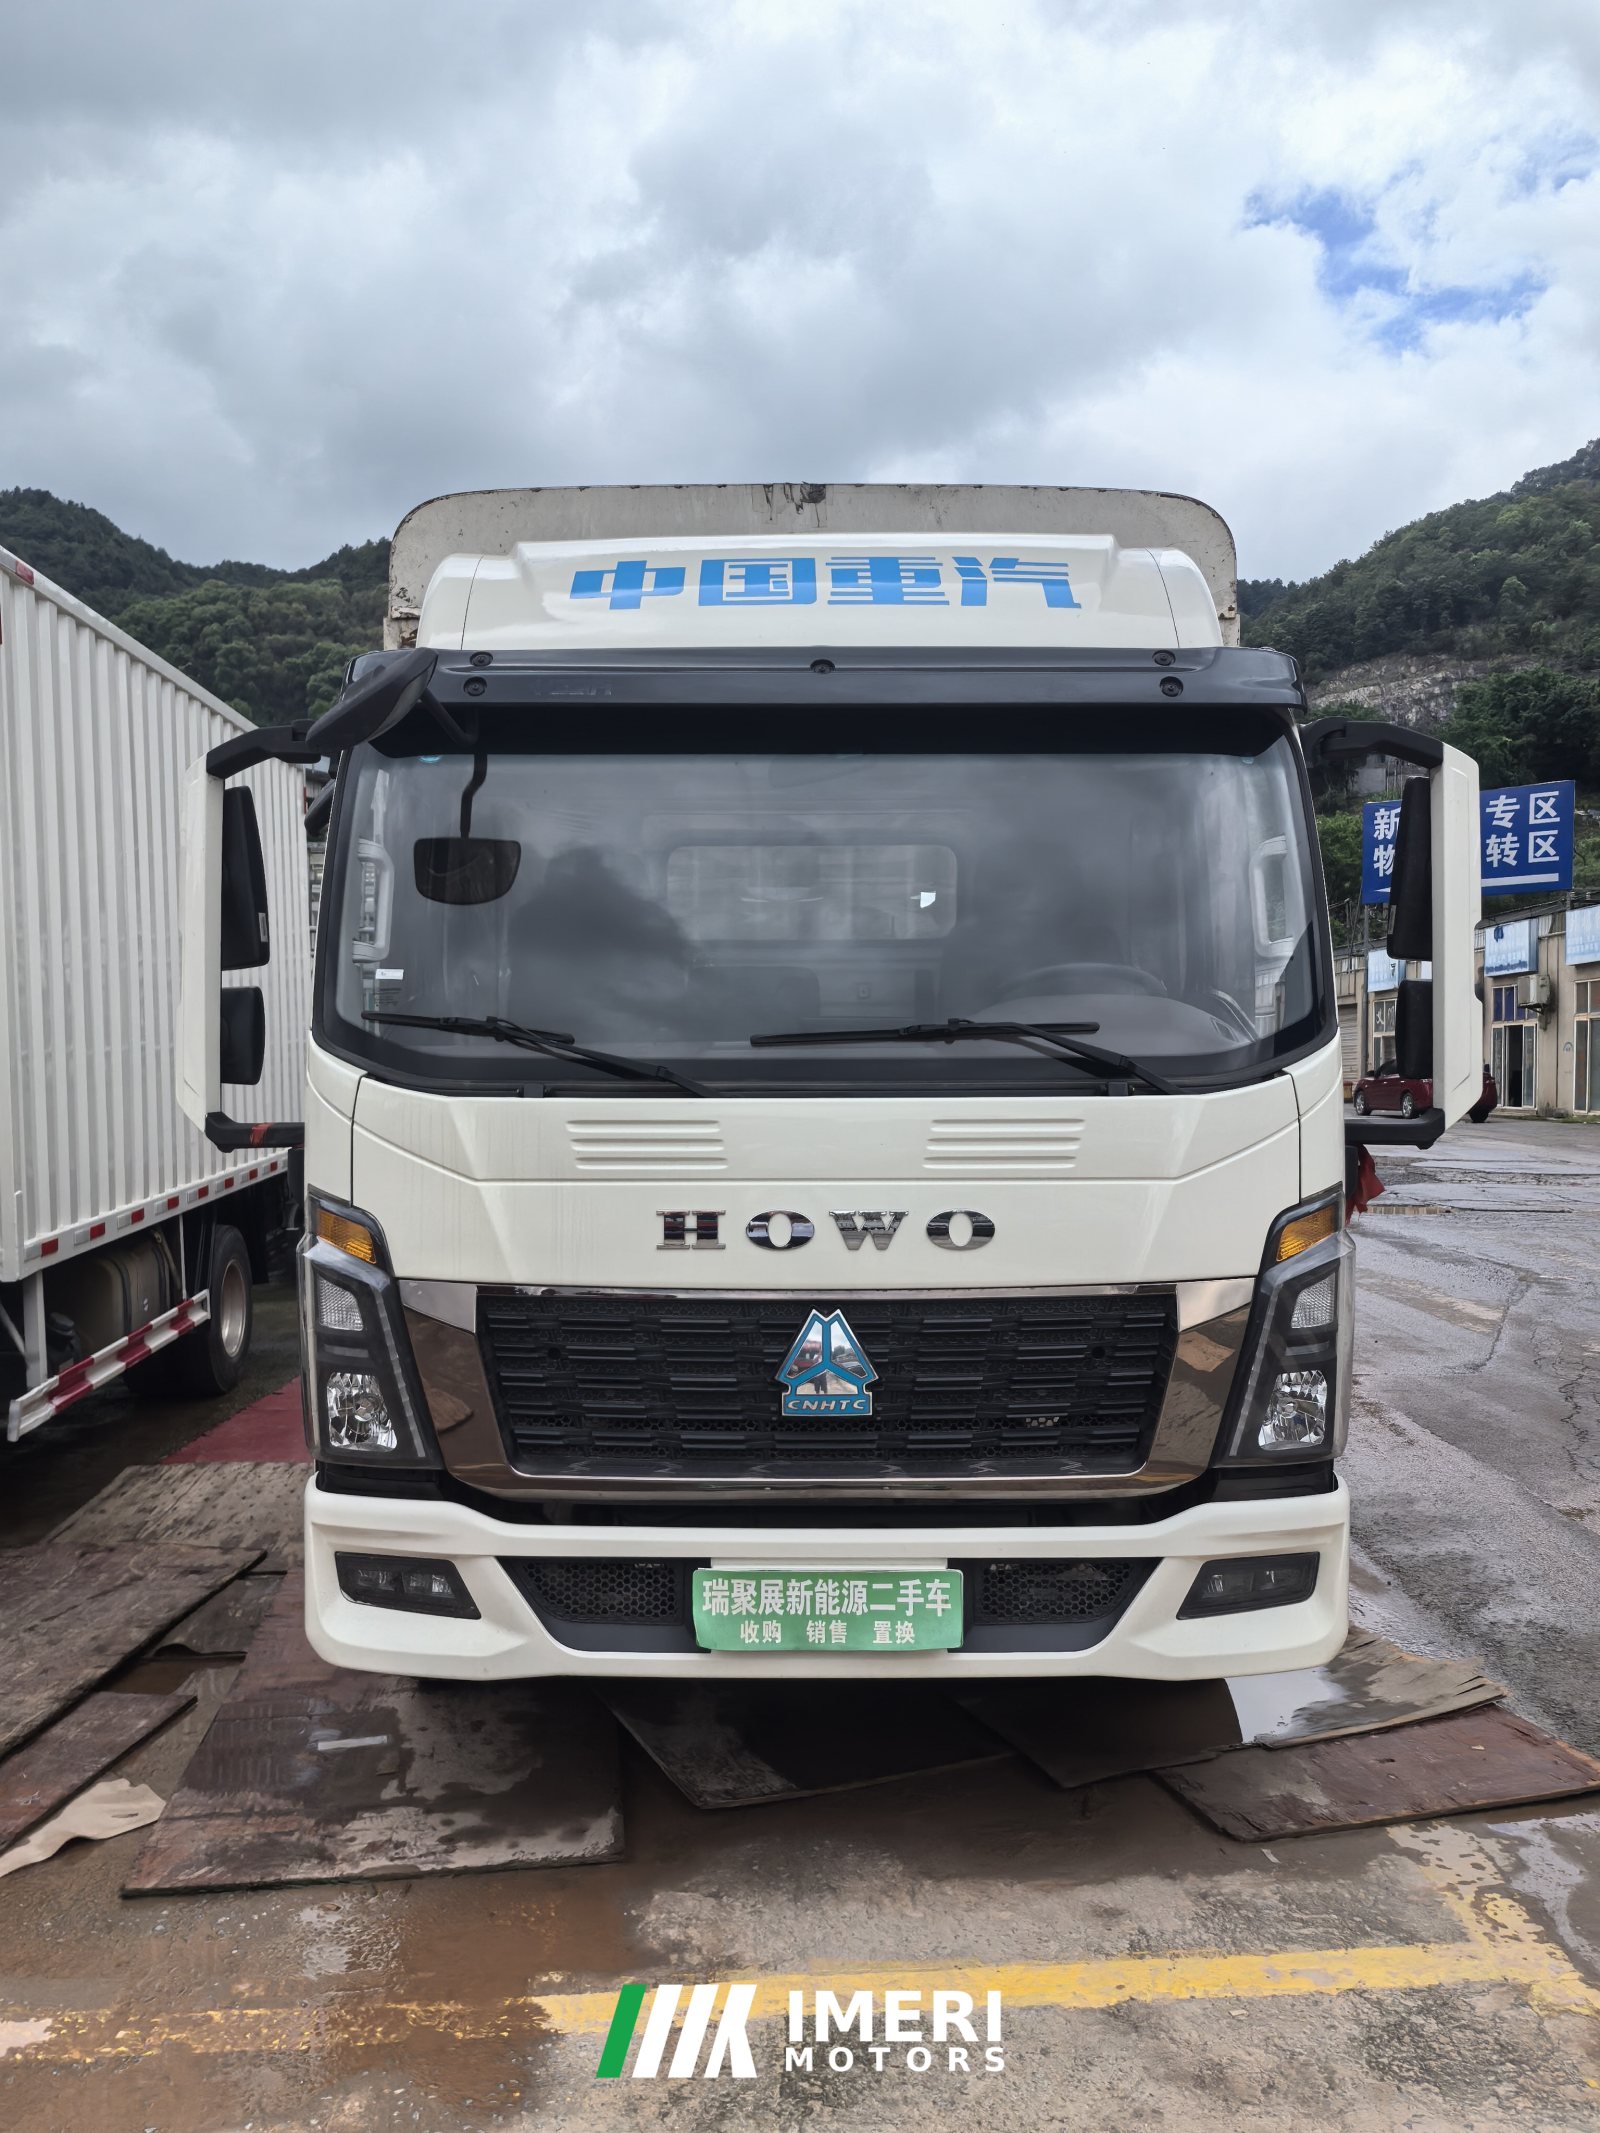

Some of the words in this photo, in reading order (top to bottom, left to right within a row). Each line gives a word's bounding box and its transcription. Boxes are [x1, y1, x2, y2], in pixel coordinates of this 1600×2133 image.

[569, 556, 1082, 610] 中国重汽
[656, 1209, 996, 1251] HOWO
[787, 1399, 866, 1411] CNHTC
[702, 1578, 951, 1616] 瑞聚展新能源二手车
[740, 1620, 782, 1644] 收购
[806, 1620, 847, 1644] 销售
[872, 1620, 915, 1644] 置换
